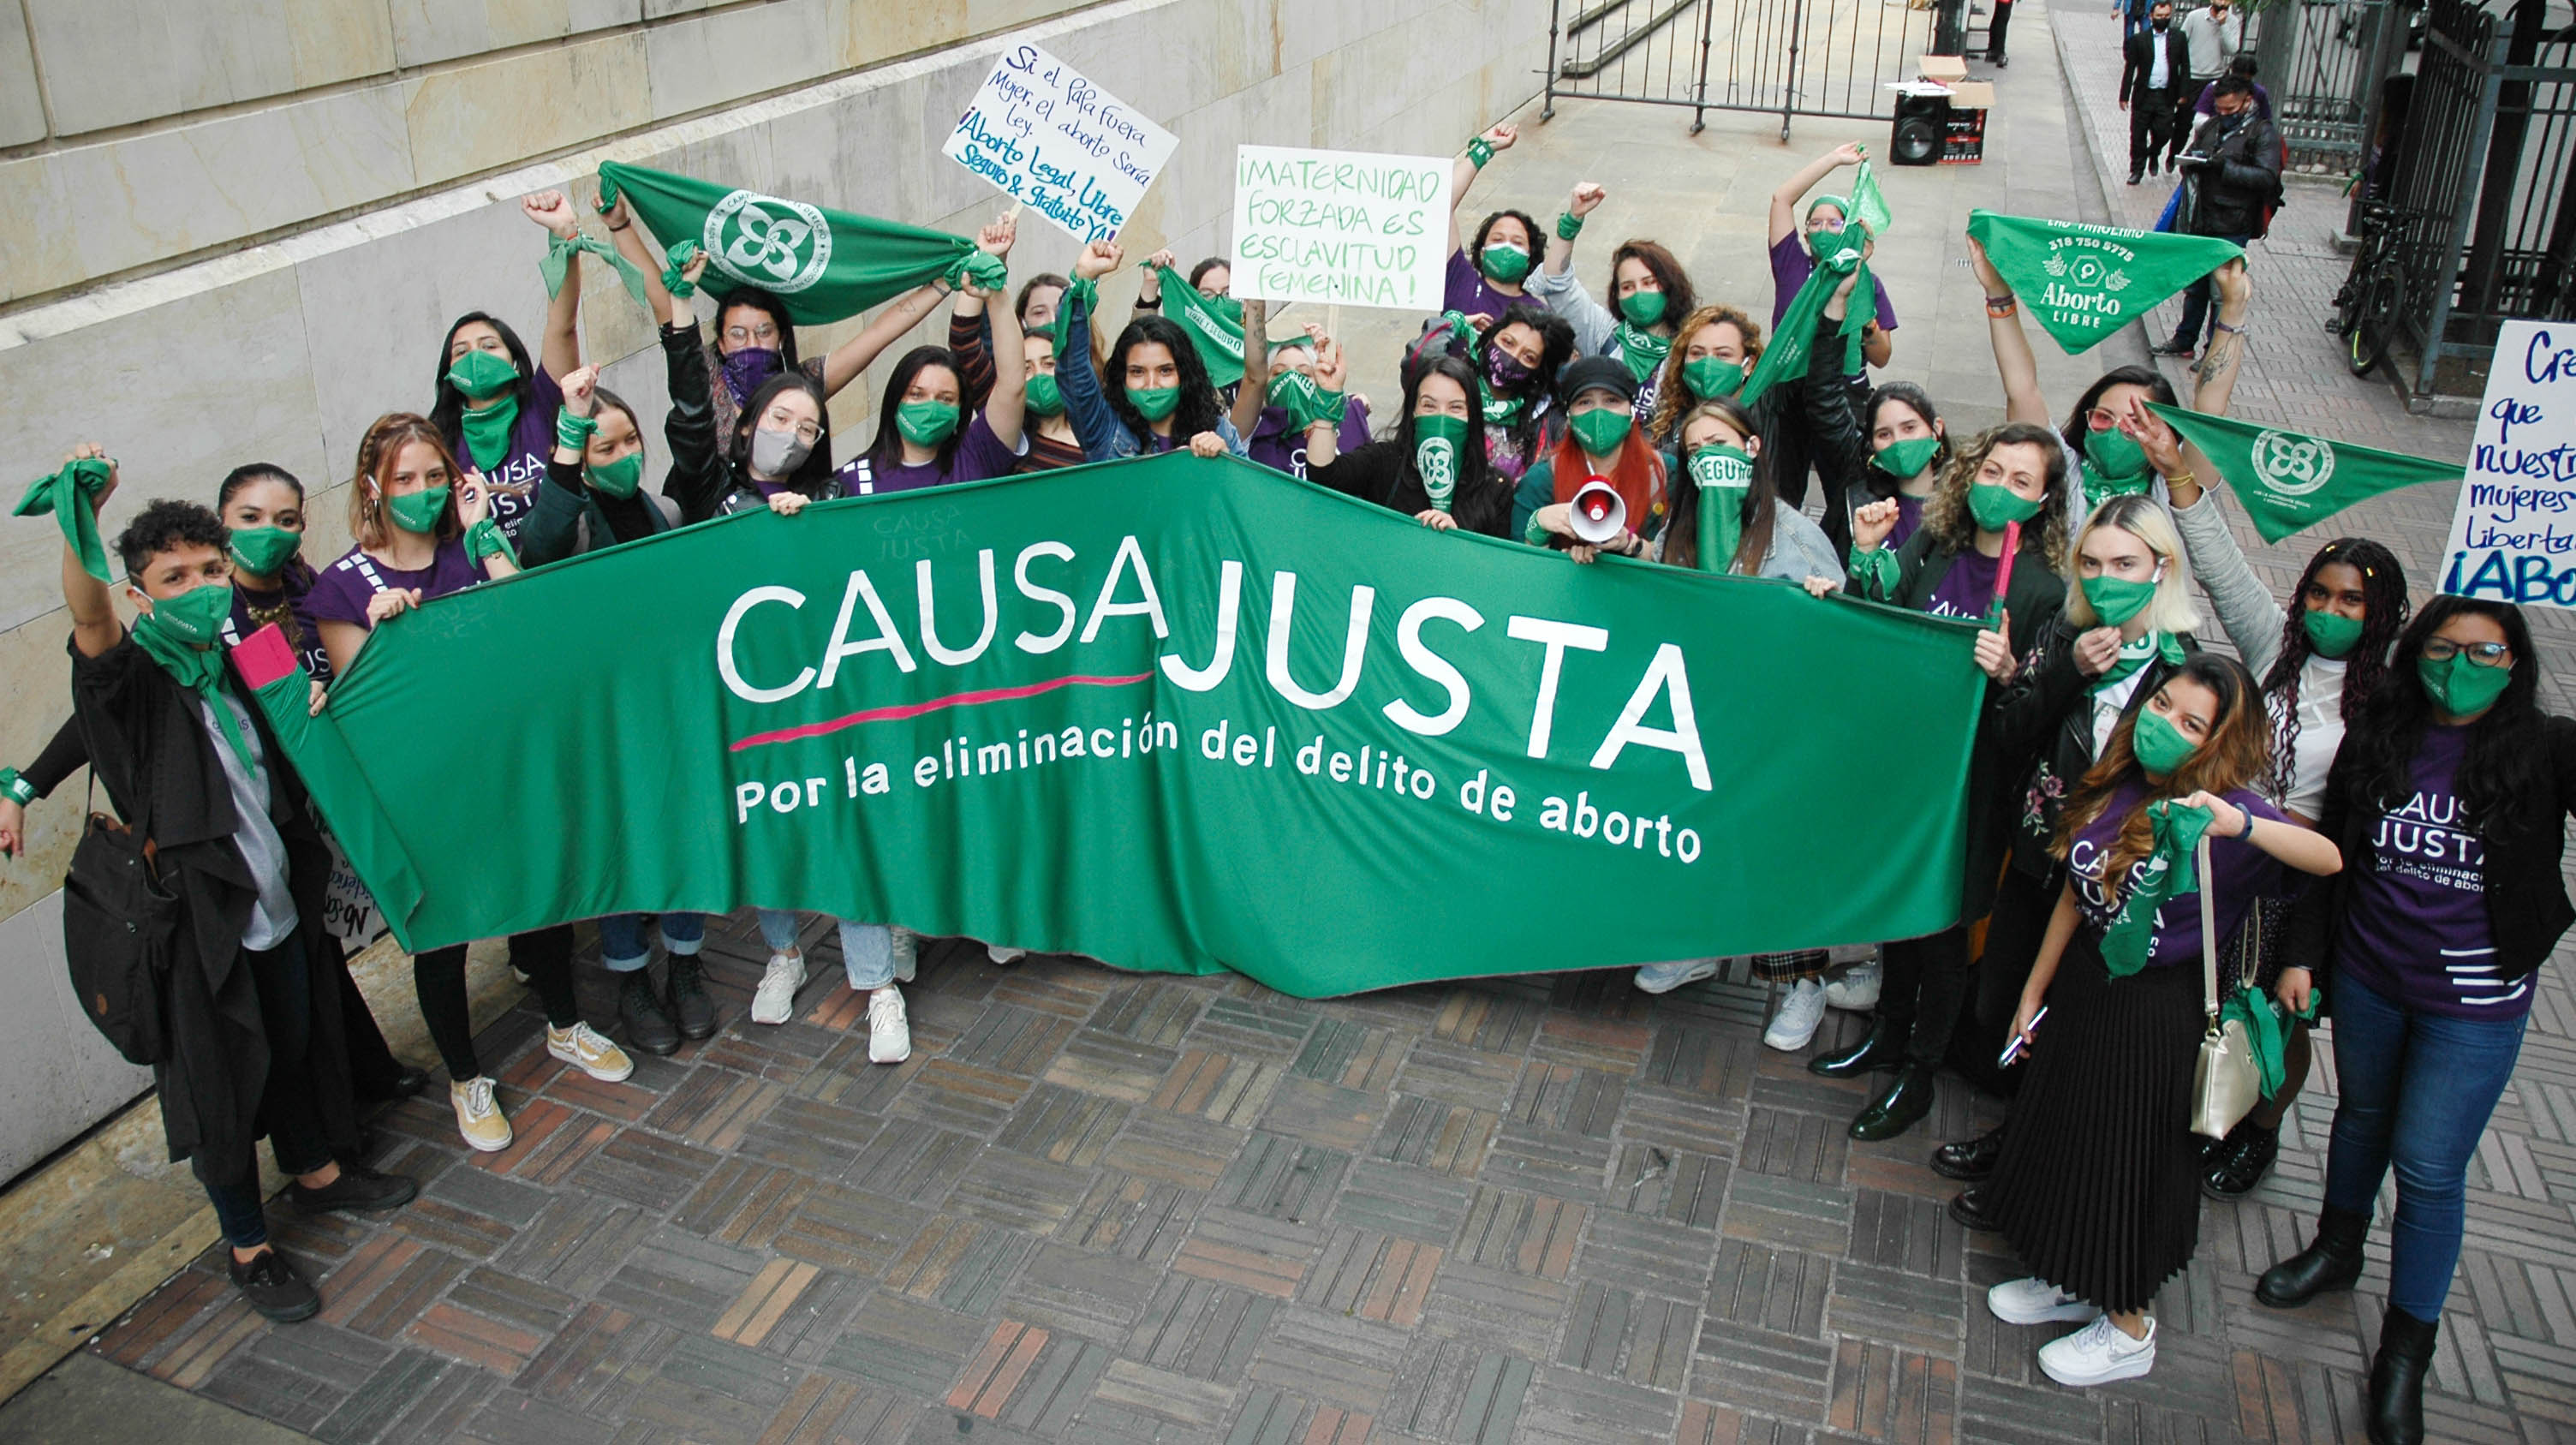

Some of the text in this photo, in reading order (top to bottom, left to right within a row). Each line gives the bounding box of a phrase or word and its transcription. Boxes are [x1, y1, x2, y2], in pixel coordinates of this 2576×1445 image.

[1006, 45, 1038, 75] Si
[1044, 67, 1060, 88] el
[1036, 99, 1055, 122] el
[1058, 119, 1110, 158] aborto
[956, 144, 1008, 185] Seguro
[1008, 175, 1024, 196] &
[1239, 154, 1440, 203] ¡MATERNIDAD
[1248, 189, 1424, 236] FORZADA ES
[1239, 233, 1416, 272] ESCLAVITUD
[2048, 236, 2135, 262] 318 750 5775
[2040, 282, 2121, 315] Aborto
[2053, 310, 2101, 328] LIBRE
[2490, 397, 2543, 445] que
[1699, 459, 1754, 481] EGURO
[717, 534, 1713, 791] CAUSA JUSTA
[845, 756, 891, 798] la
[914, 711, 1178, 787] eliminación
[1202, 719, 1276, 768] del
[1296, 735, 1436, 800] delito
[1459, 769, 1516, 822] de
[1539, 790, 1702, 864] aborto
[2372, 821, 2484, 866] JUST
[2434, 874, 2450, 886] de
